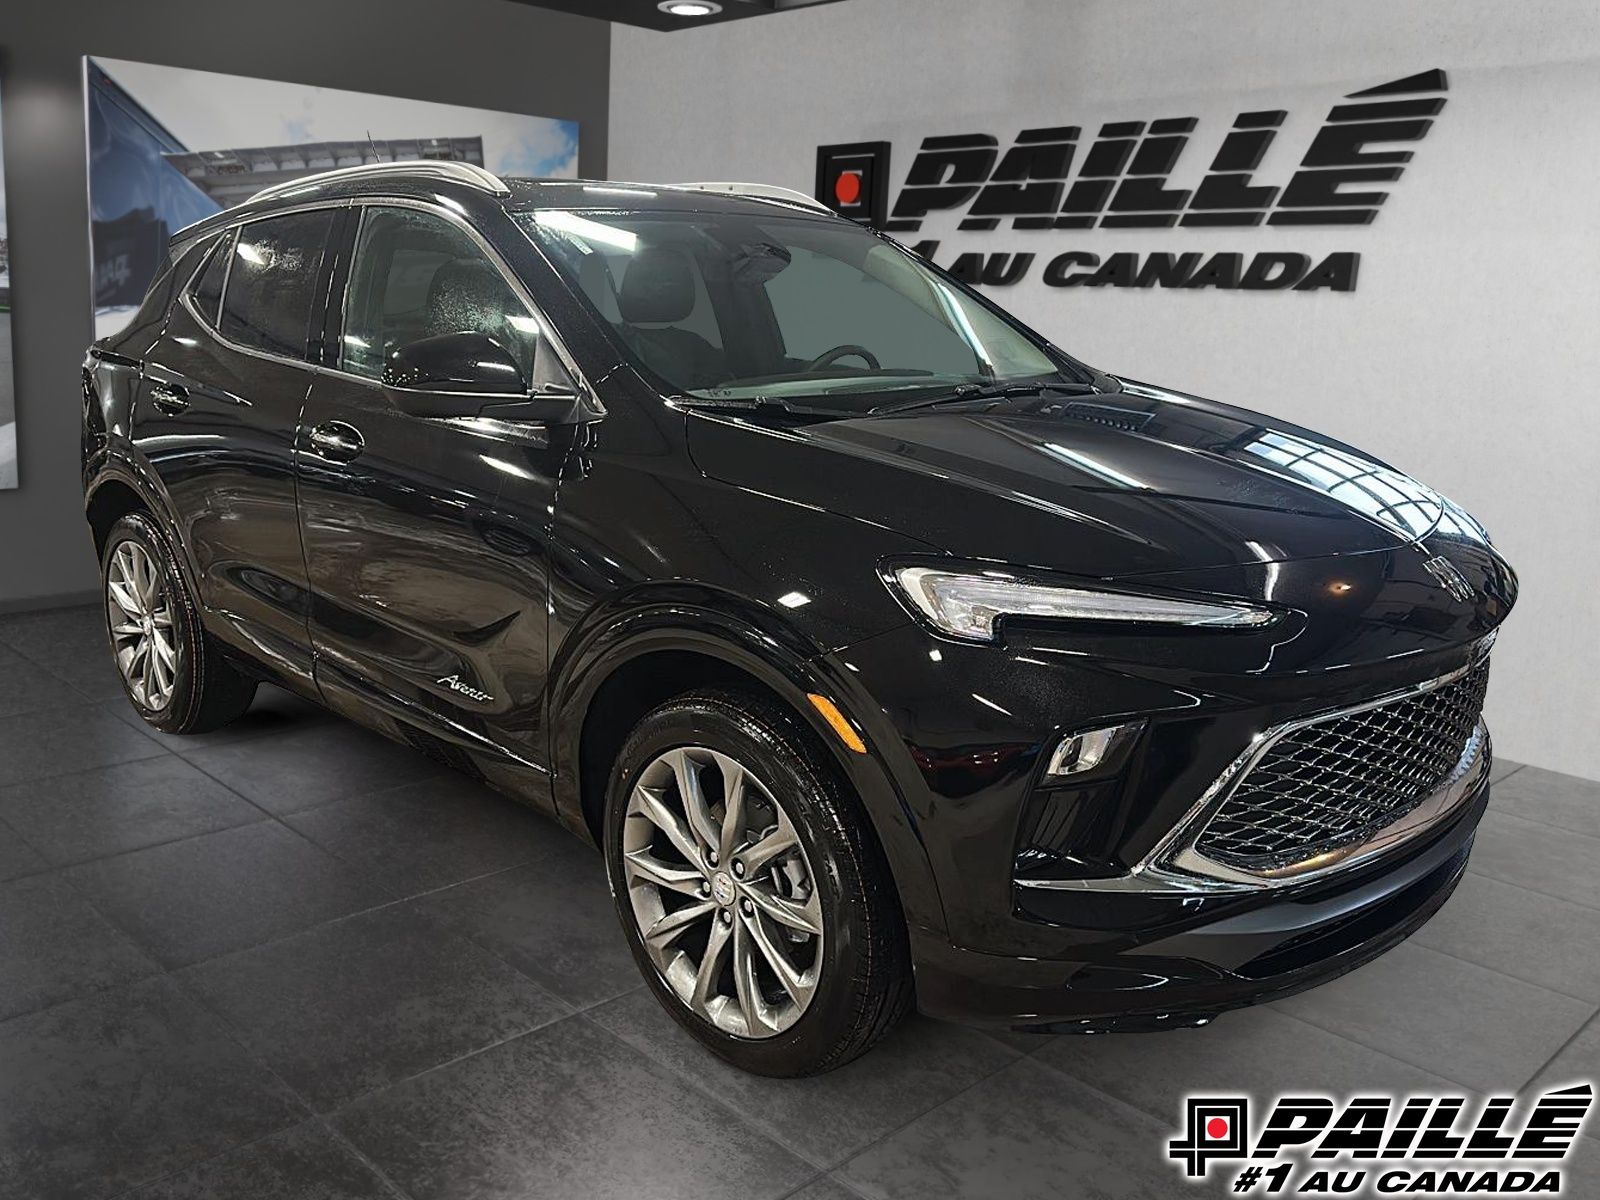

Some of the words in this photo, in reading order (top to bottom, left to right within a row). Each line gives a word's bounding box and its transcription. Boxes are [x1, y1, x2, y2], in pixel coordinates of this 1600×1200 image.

[886, 68, 1448, 231] PAILLÉ
[947, 252, 1037, 286] AU
[1042, 251, 1361, 292] CANADA
